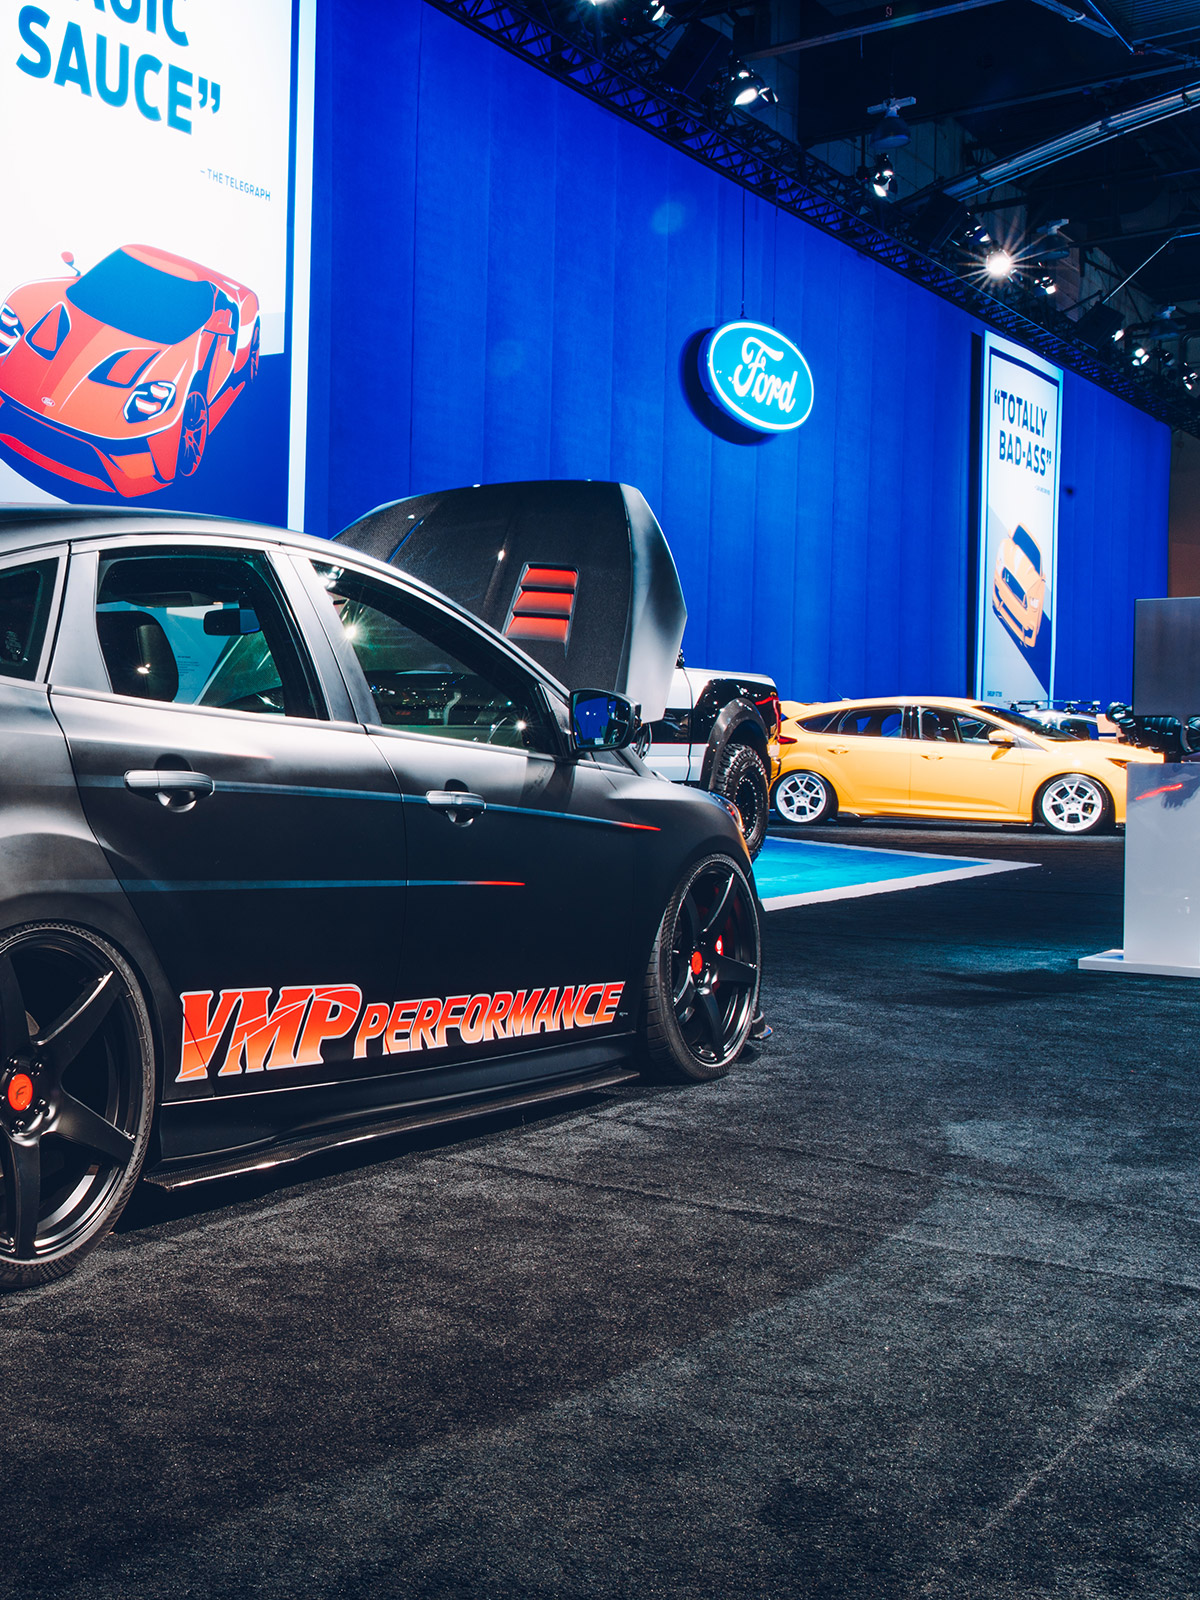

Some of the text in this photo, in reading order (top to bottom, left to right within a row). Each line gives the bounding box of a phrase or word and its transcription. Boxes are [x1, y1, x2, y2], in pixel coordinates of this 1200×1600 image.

[15, 4, 222, 136] SAUCE”
[207, 167, 224, 184] THE
[225, 174, 271, 202] TELEGRAPH
[732, 335, 798, 413] Ford
[993, 388, 1048, 438] “TOTALLY
[174, 982, 363, 1083] VMP
[352, 980, 626, 1060] PERFORMANCE
